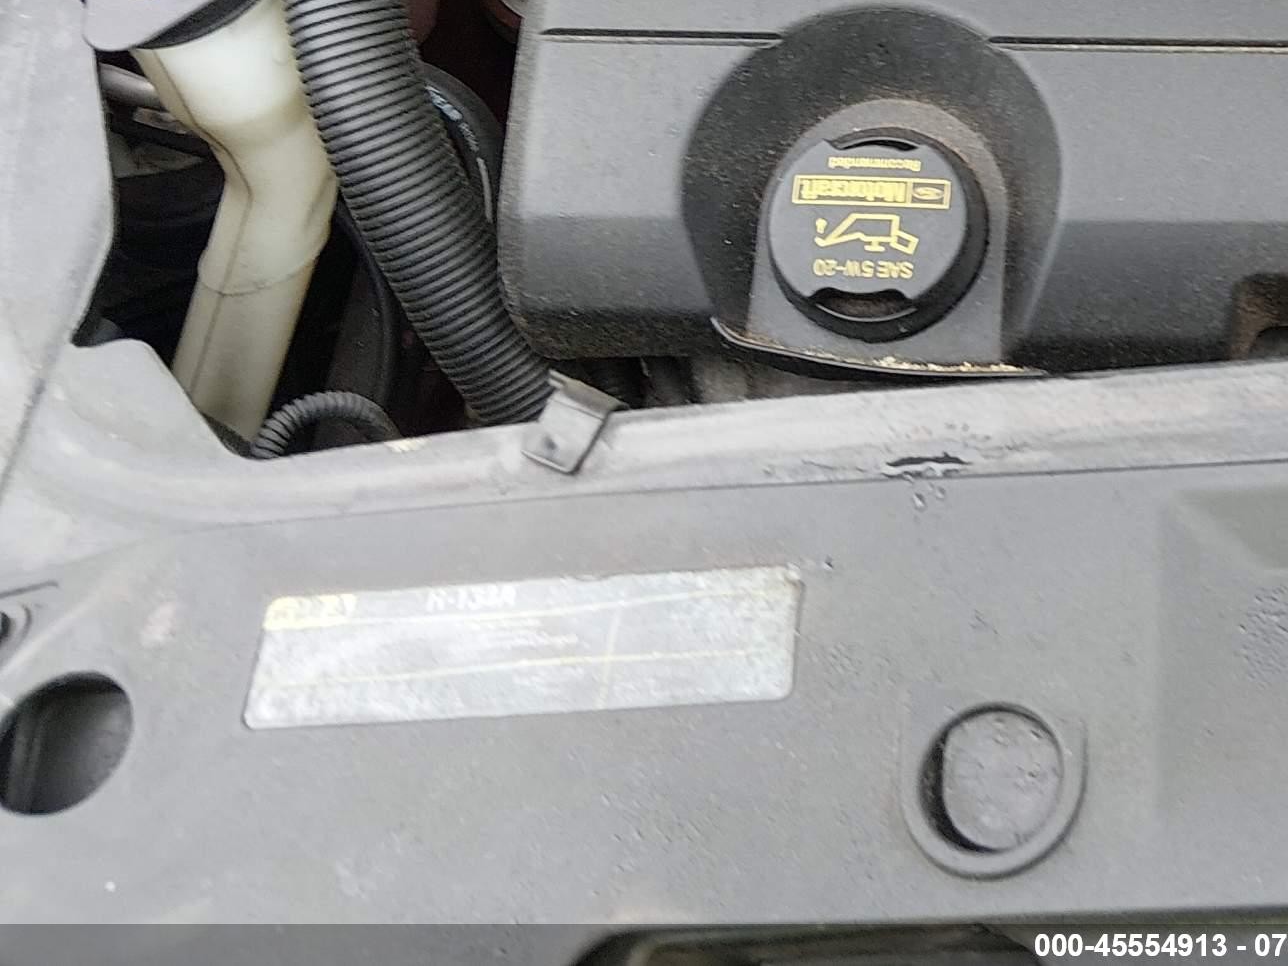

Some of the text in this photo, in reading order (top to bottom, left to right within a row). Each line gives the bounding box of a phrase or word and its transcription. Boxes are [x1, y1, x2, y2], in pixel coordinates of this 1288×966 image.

[828, 156, 922, 172] Recommended
[801, 178, 906, 203] Motorcraft
[812, 258, 915, 279] SAE 5W-20
